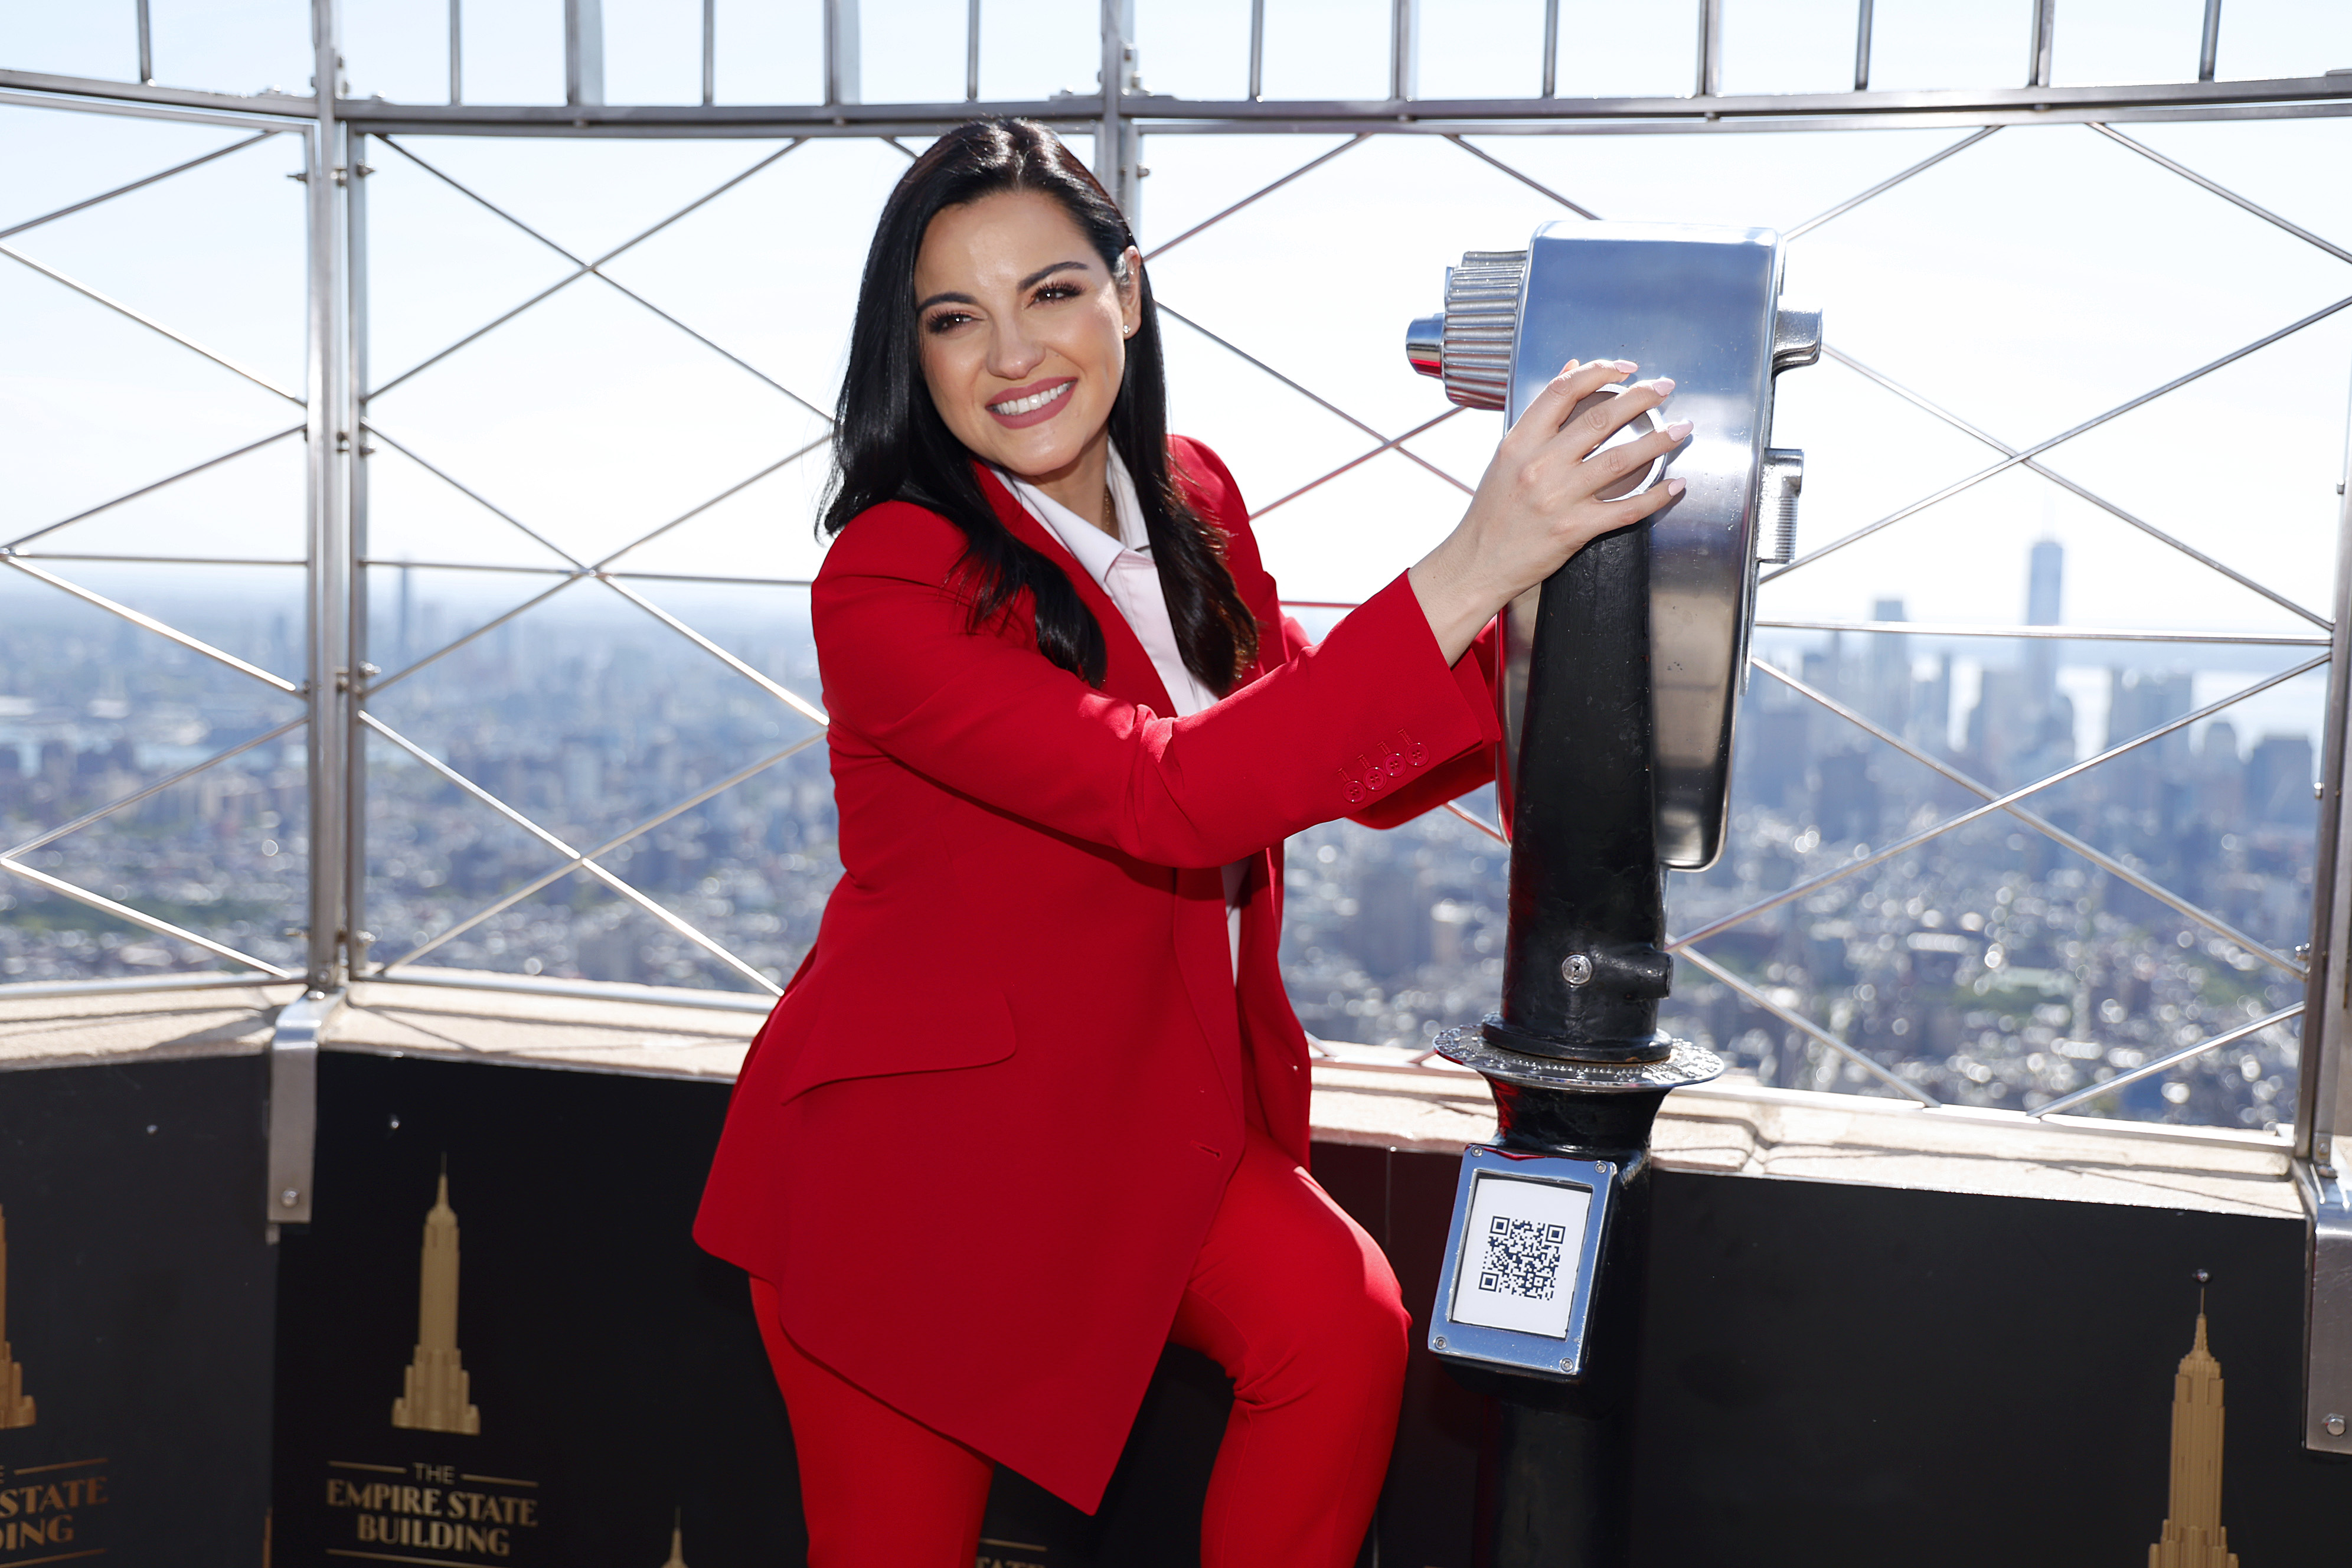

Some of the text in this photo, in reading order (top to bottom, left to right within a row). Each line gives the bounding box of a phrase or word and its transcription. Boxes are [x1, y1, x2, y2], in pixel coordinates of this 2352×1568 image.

[412, 1462, 455, 1485] THE
[0, 1476, 110, 1519] STATE
[326, 1478, 539, 1527] EMPIRE STATE
[357, 1513, 511, 1557] BUILDING
